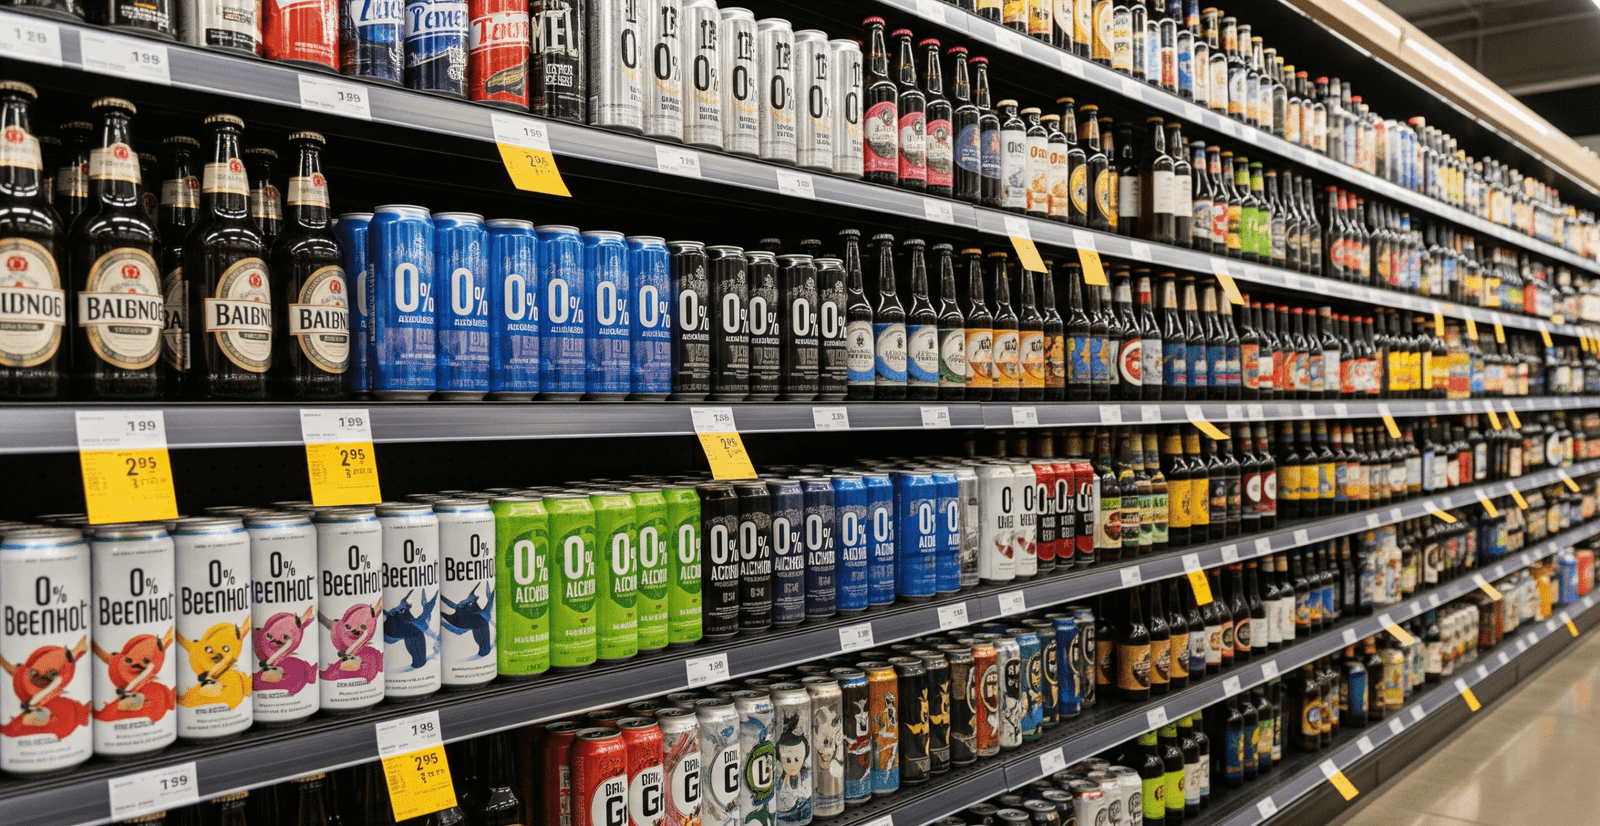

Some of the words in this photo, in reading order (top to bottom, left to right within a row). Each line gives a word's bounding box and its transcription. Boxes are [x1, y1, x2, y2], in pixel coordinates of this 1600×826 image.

[394, 262, 434, 313] 0%
[451, 267, 488, 316] 0%
[504, 273, 538, 321] 0%
[547, 278, 584, 324] 0%
[596, 280, 629, 326] 0%
[638, 285, 671, 329] 0%
[679, 289, 709, 331] 0%
[722, 293, 749, 334] 0%
[749, 296, 779, 335] 0%
[792, 298, 818, 336] 0%
[821, 301, 847, 339] 0%
[125, 456, 157, 476] 295
[340, 448, 366, 467] 295
[270, 551, 296, 578] 0%
[348, 545, 371, 571] 0%
[403, 539, 427, 564] 0%
[470, 534, 489, 558] 0%
[36, 576, 67, 606] 0%
[130, 568, 158, 597] 0%
[209, 559, 236, 588] 0%
[415, 752, 438, 771] 295
